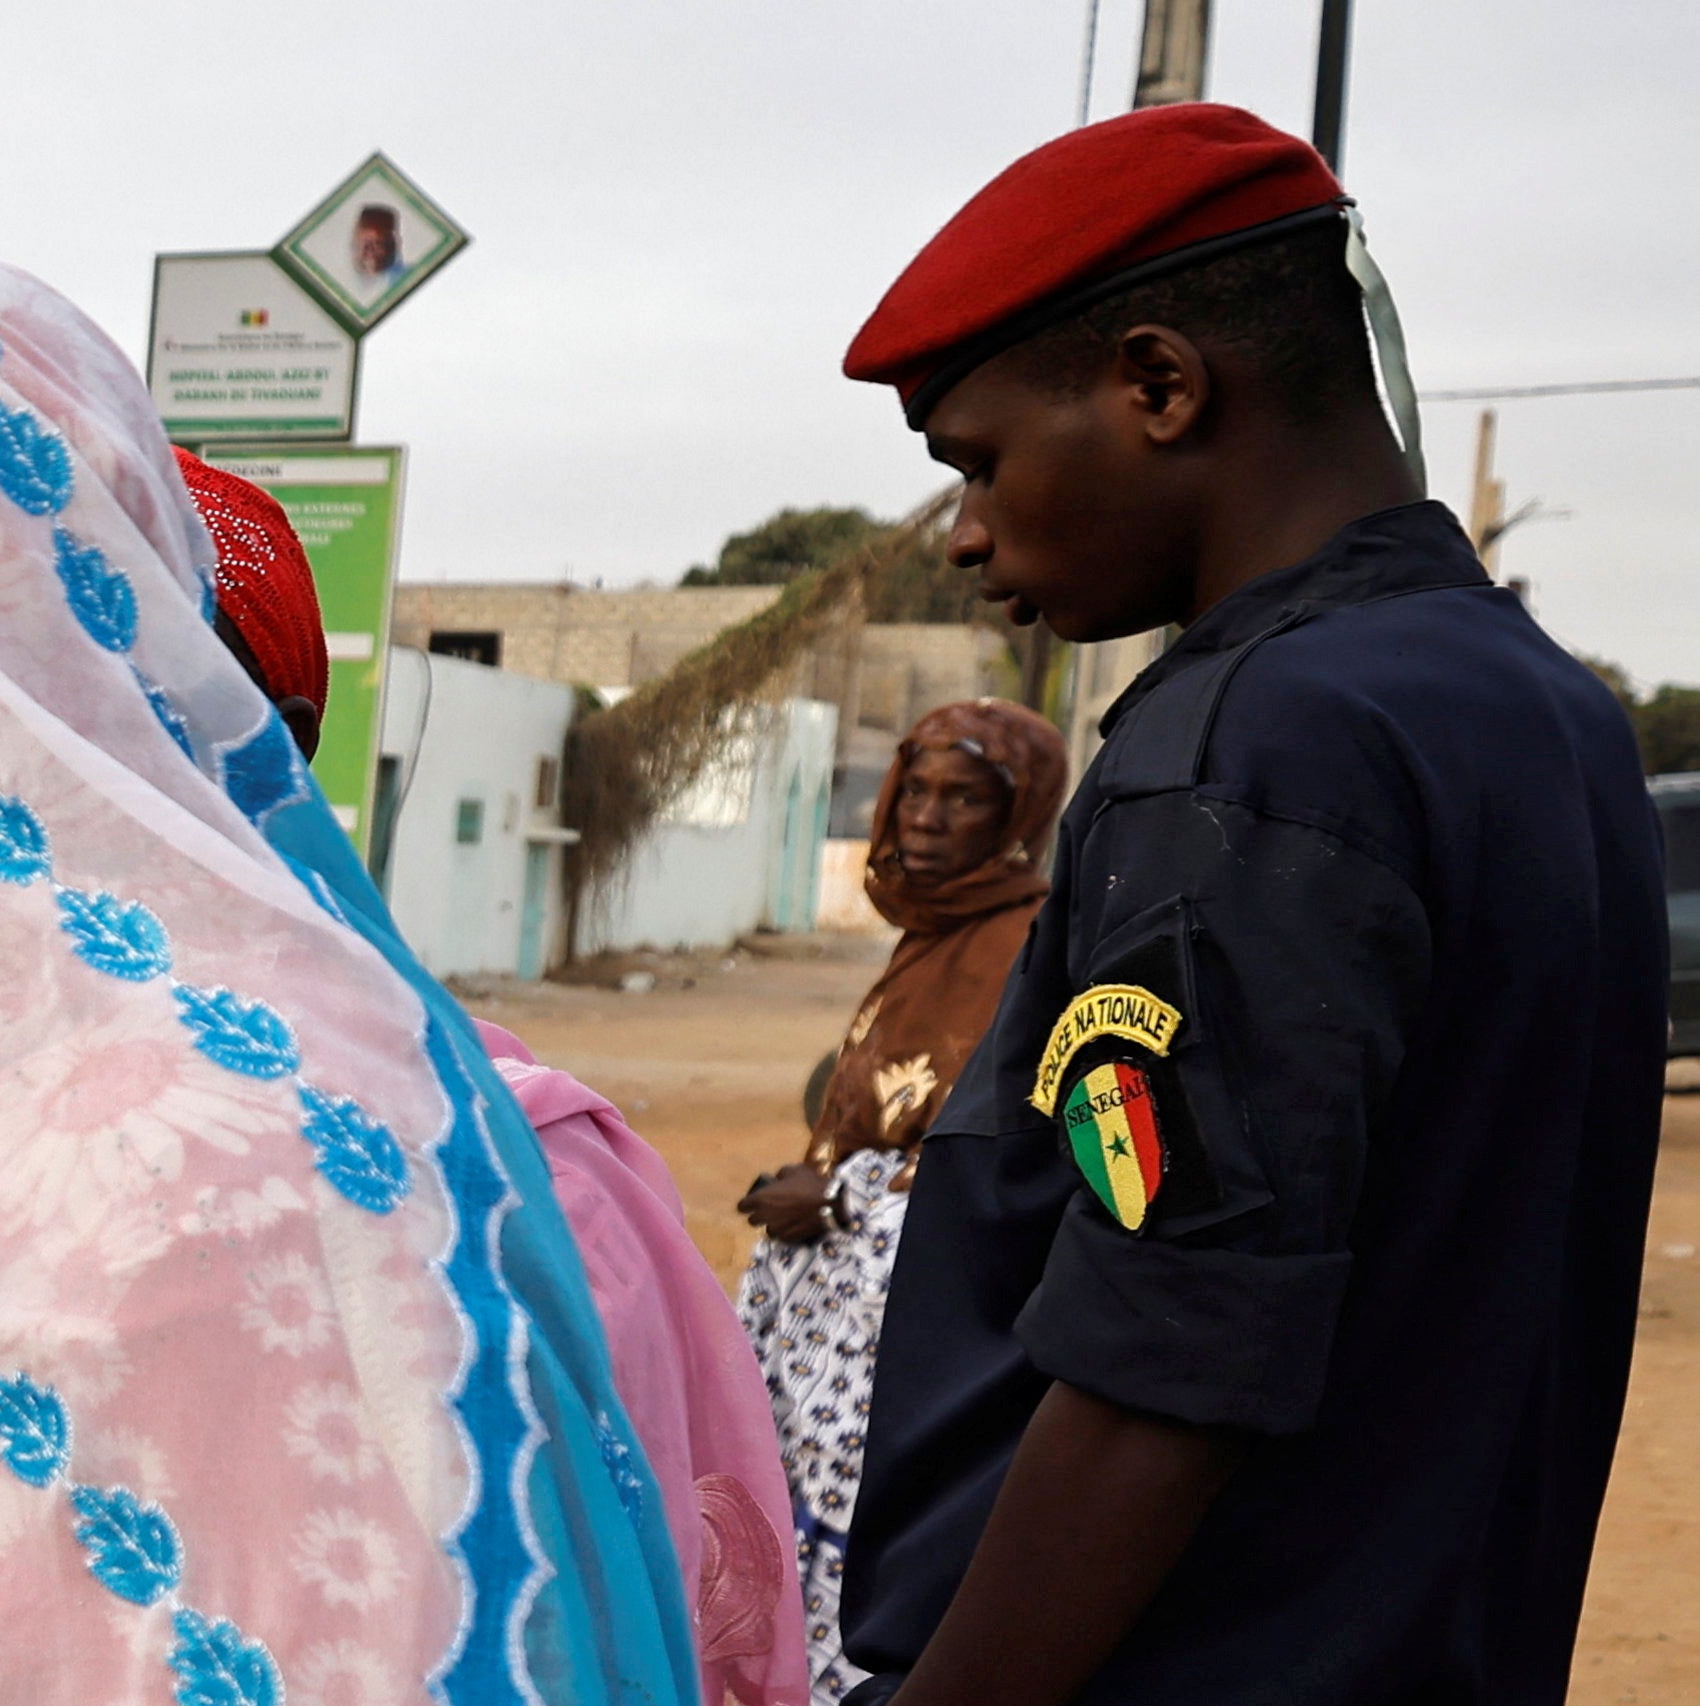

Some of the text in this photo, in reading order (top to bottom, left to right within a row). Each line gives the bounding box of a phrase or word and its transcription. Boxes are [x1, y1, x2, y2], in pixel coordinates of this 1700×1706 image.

[1041, 996, 1169, 1100] POLICE NATIONALE
[1067, 1073, 1149, 1129] SENEGAL
